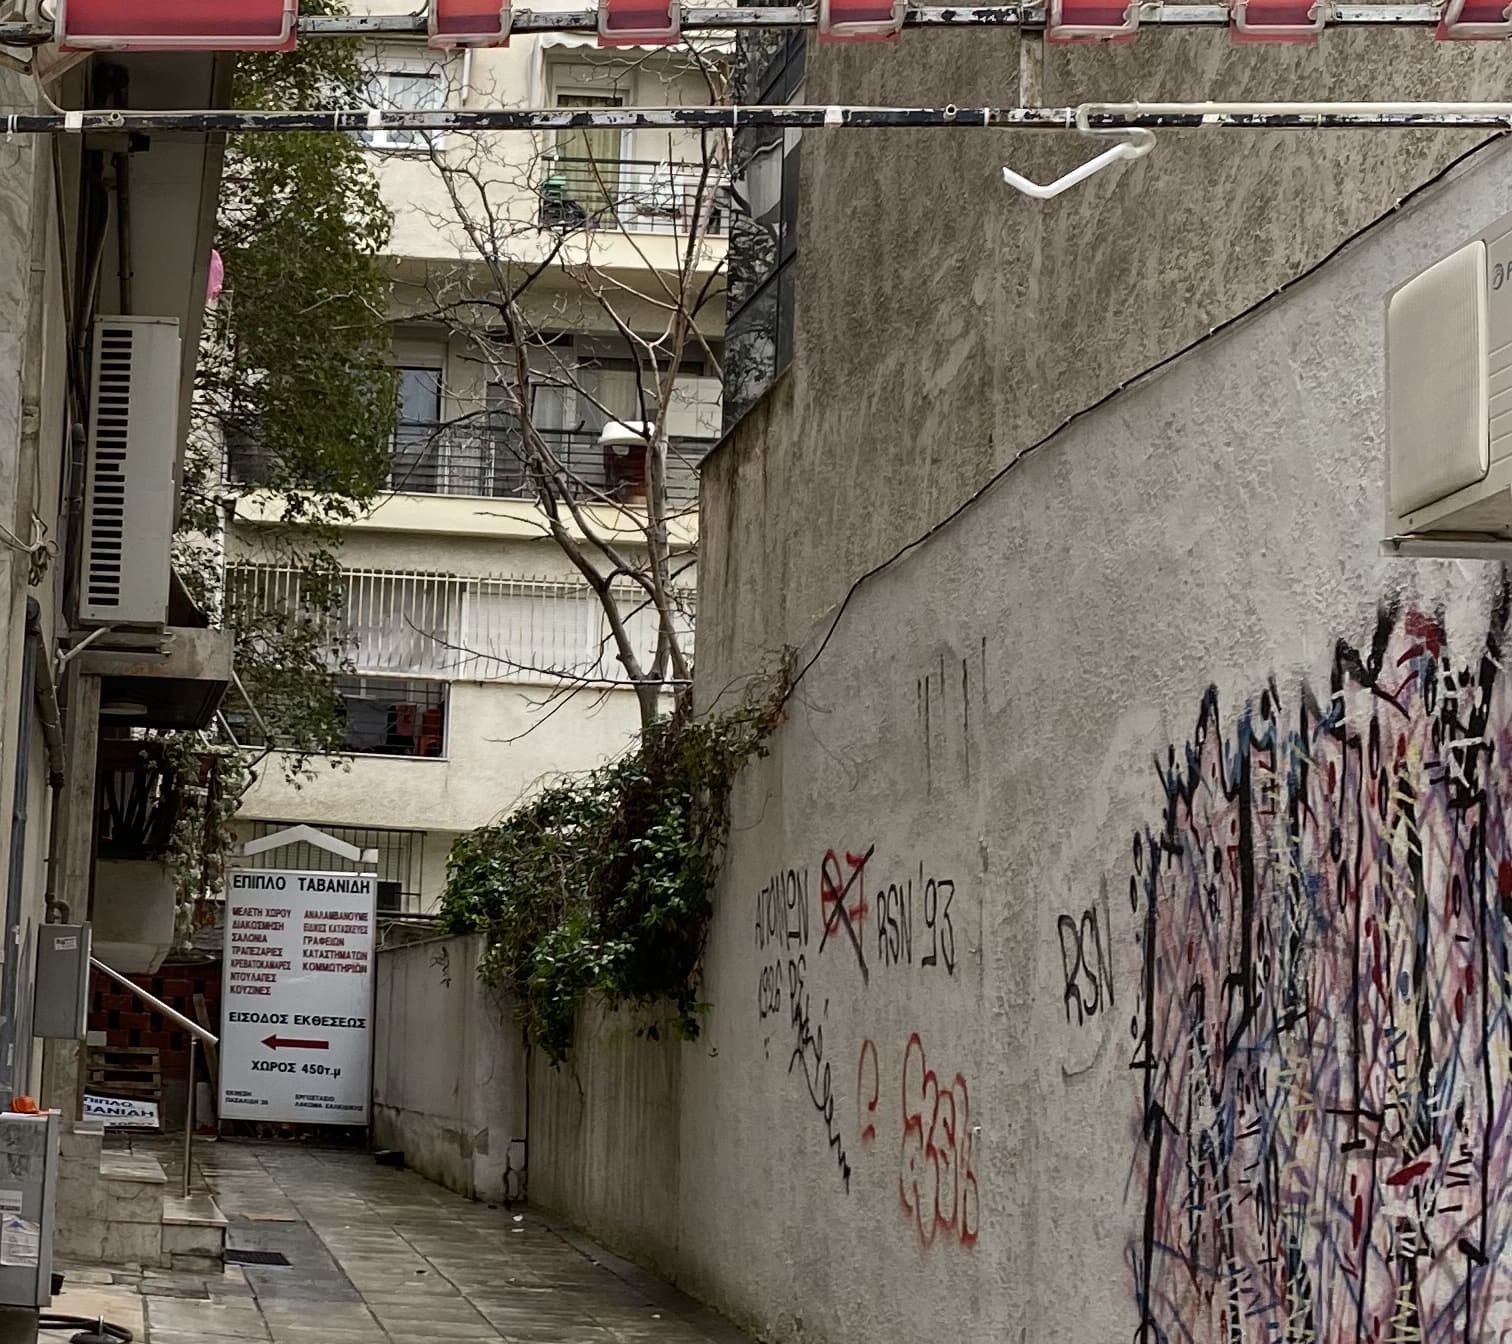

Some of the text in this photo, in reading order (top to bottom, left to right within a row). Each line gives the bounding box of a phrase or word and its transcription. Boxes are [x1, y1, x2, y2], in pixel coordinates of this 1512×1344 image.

[233, 875, 370, 894] ΕΠΙΠΛΟ ΤΑΒΑΝΙΔΗ
[265, 908, 291, 918] ΧΩΡΟΥ
[231, 933, 267, 943] ΣΑΛΟΝΙΑ
[303, 936, 345, 946] ΓΡΑΦΕΙΩΝ
[303, 949, 368, 960] ΚΑΤΑΣΤΗΜΑΤΩΝ
[228, 1012, 367, 1029] ΕΙΣΟΔΟΣ ΕΚΘΕΣΕΩΣ
[251, 1060, 297, 1073] ΧΩΡΟΣ
